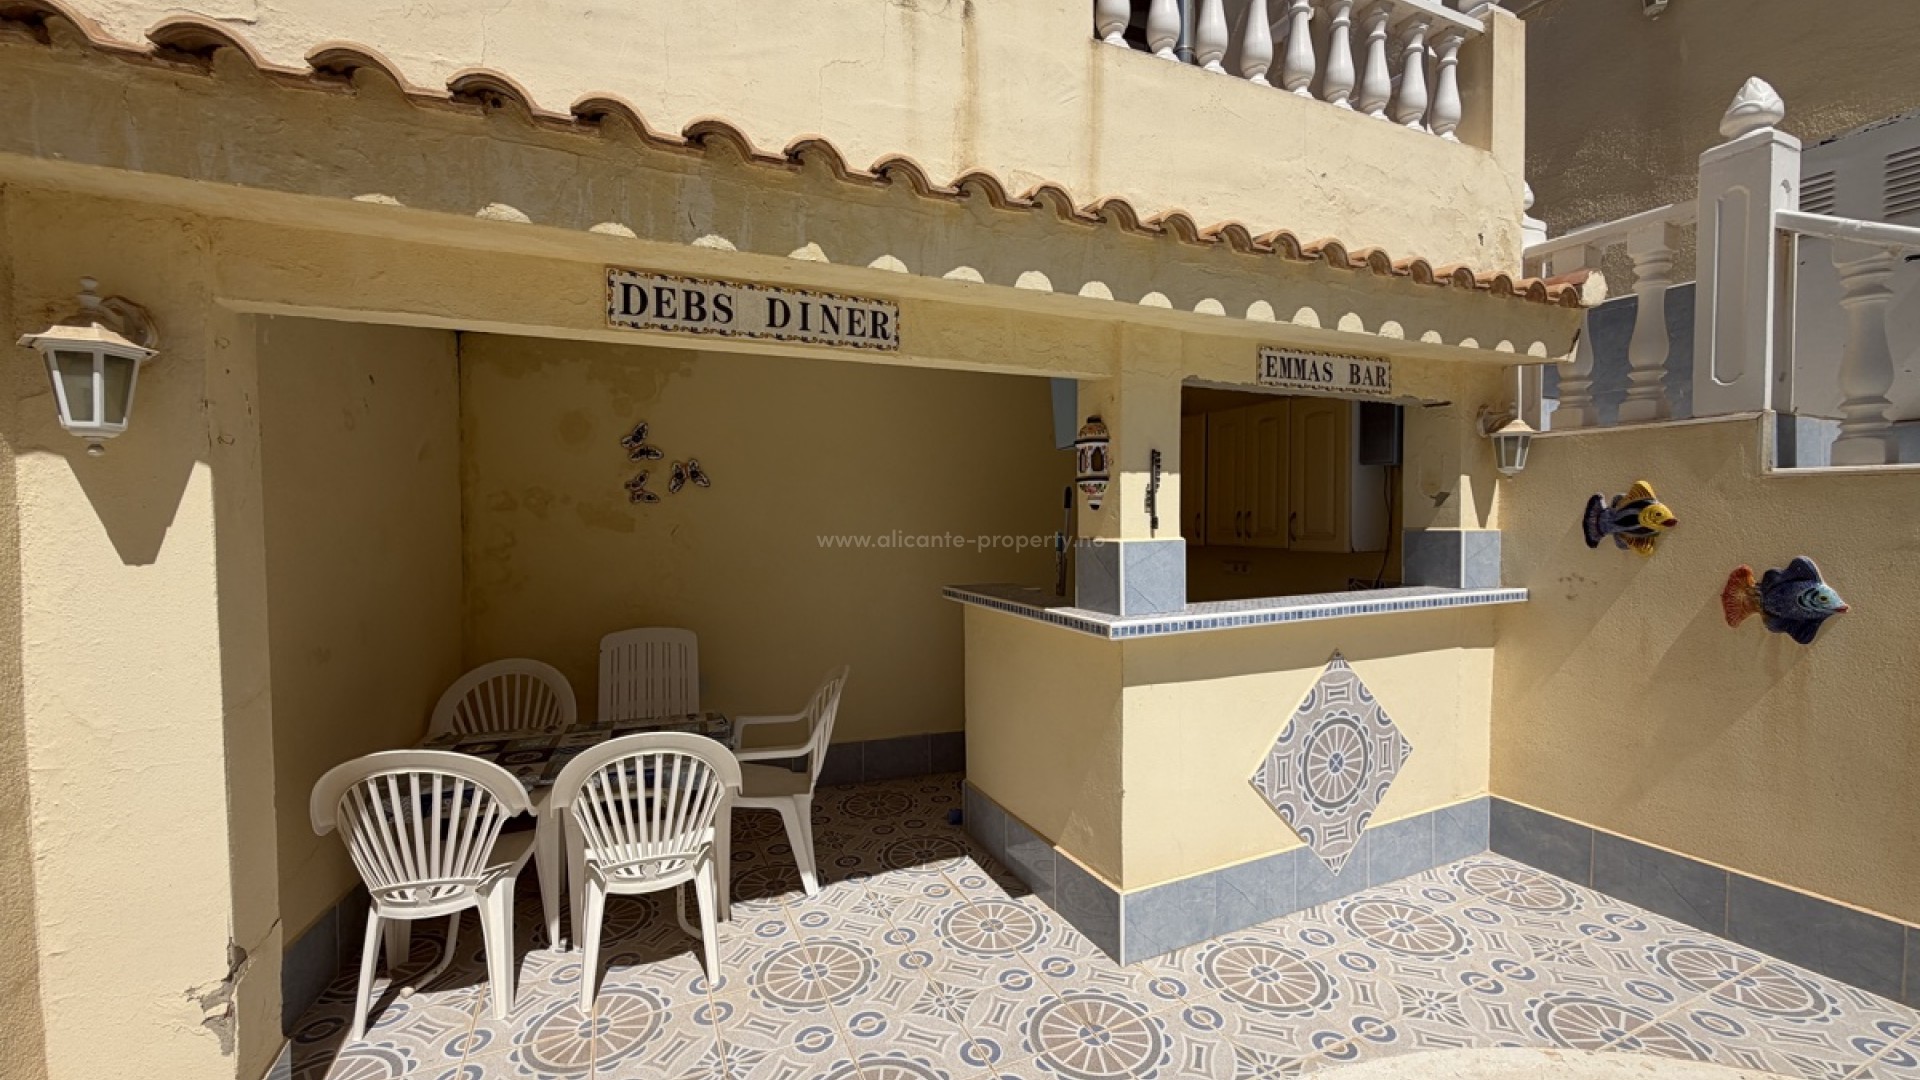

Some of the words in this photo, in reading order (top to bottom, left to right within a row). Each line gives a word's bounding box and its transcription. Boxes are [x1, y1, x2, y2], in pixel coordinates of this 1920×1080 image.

[620, 282, 733, 324] DEBS
[767, 297, 890, 340] DINER
[1265, 355, 1333, 382] EMMAS
[1349, 363, 1386, 387] BAR
